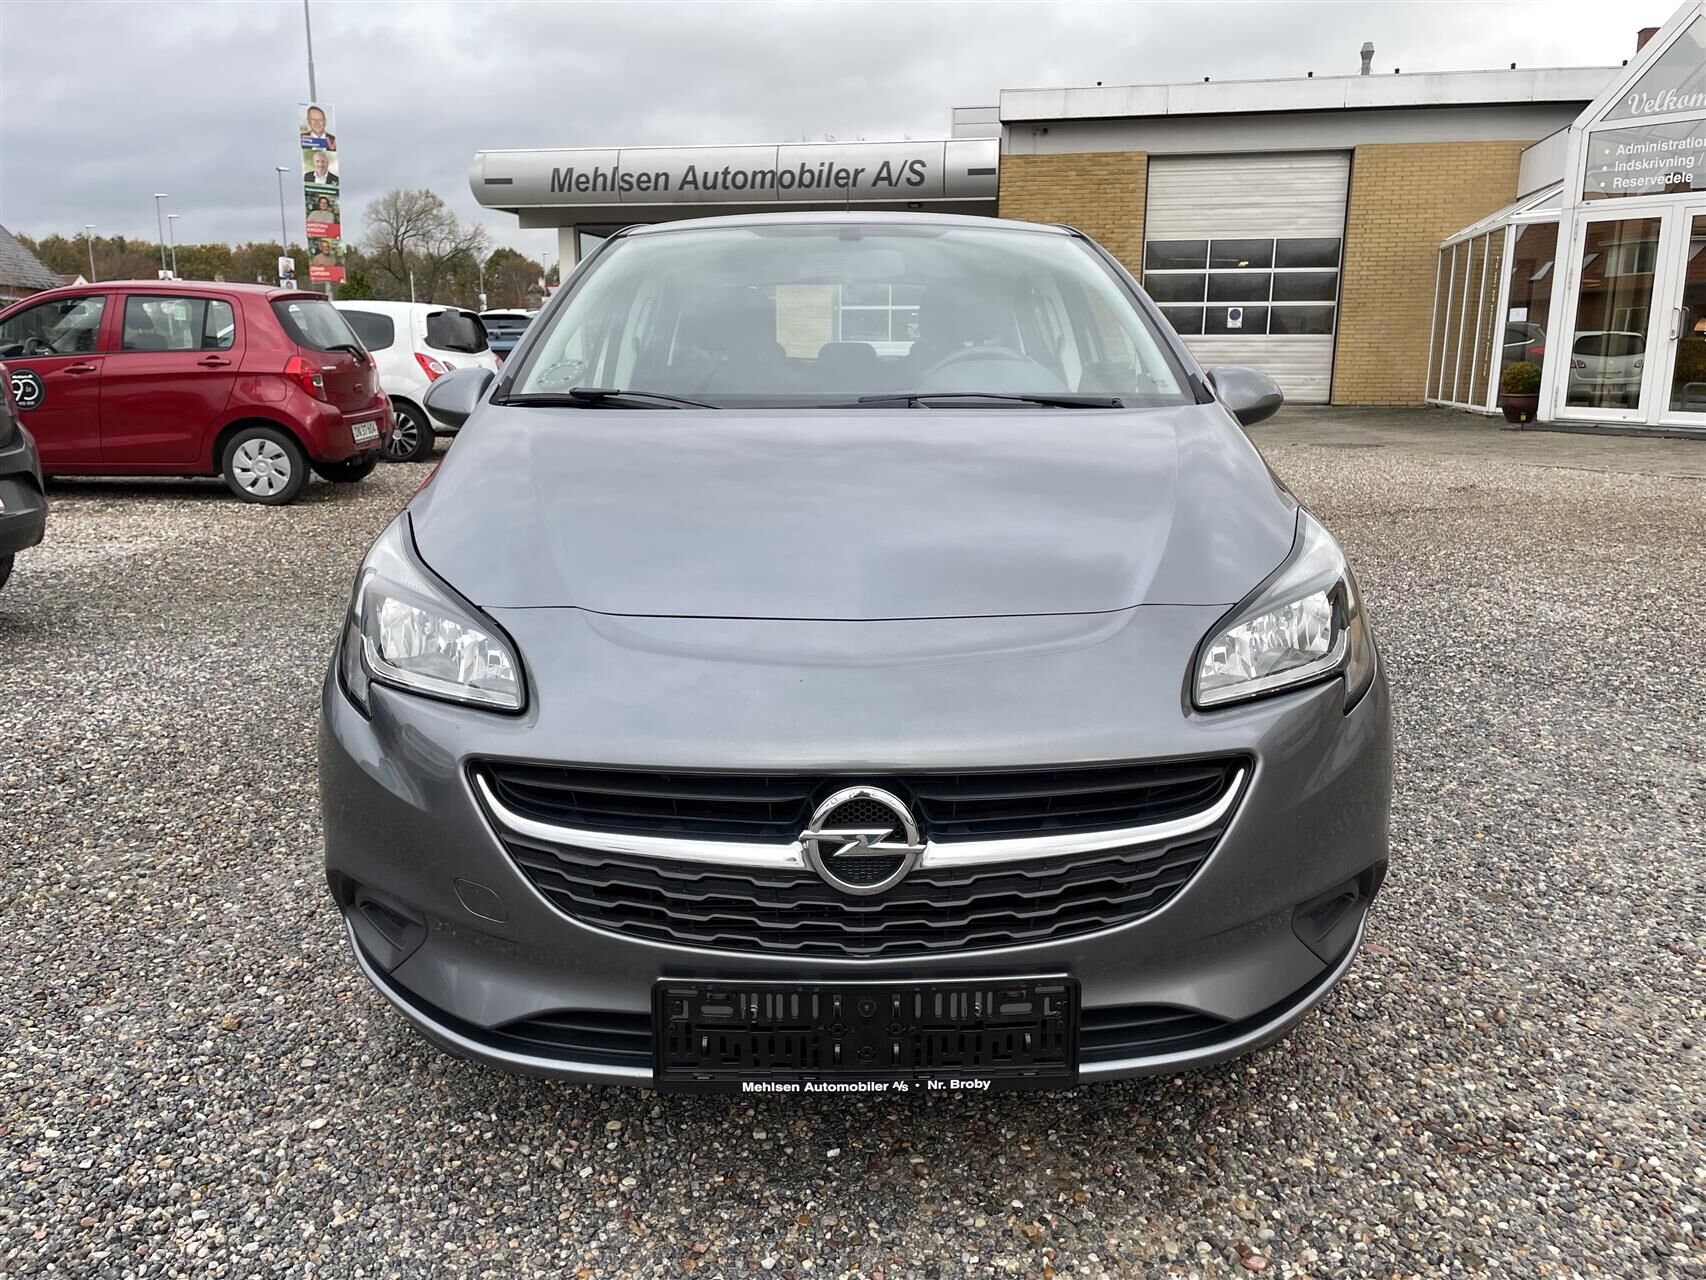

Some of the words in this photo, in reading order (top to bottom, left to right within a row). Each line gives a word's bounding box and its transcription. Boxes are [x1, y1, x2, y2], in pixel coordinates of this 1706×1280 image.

[1614, 155, 1695, 172] Indskrivning
[550, 166, 670, 193] Mehlsen
[678, 161, 866, 191] Automobiler
[871, 159, 927, 188] A/S
[1613, 171, 1693, 188] Reservedele
[742, 1081, 800, 1092] Mehlsen
[803, 1081, 889, 1092] Automobiler
[927, 1079, 947, 1090] Nr.
[950, 1078, 991, 1091] Broby
